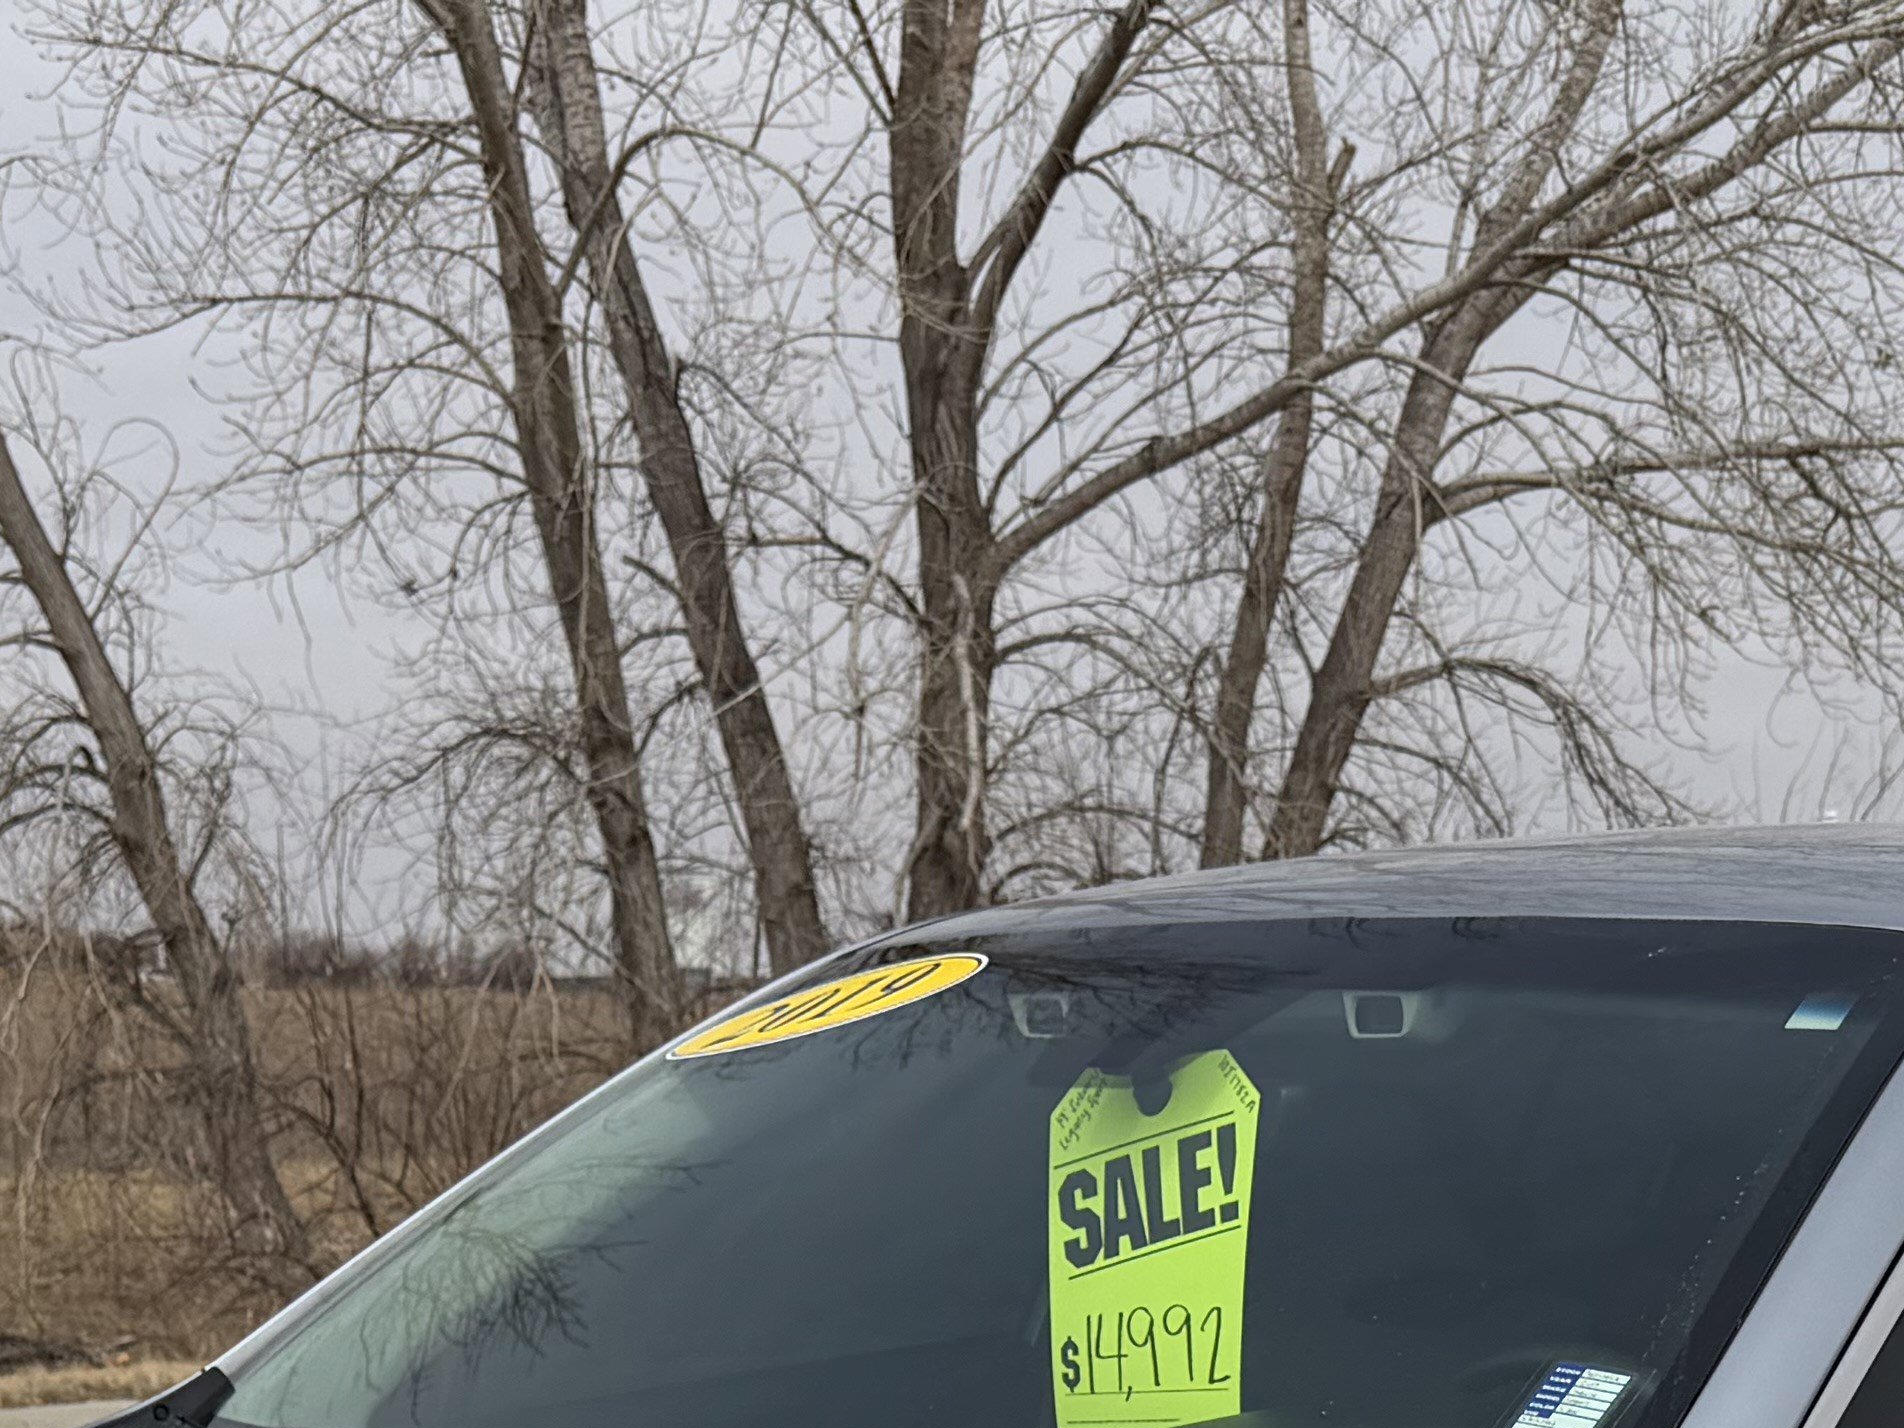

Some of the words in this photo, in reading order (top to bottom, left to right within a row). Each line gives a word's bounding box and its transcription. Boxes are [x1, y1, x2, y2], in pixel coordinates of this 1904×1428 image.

[700, 963, 943, 1048] 2019
[1058, 1122, 1240, 1270] SALE!
[1059, 1304, 1232, 1403] $14,992
